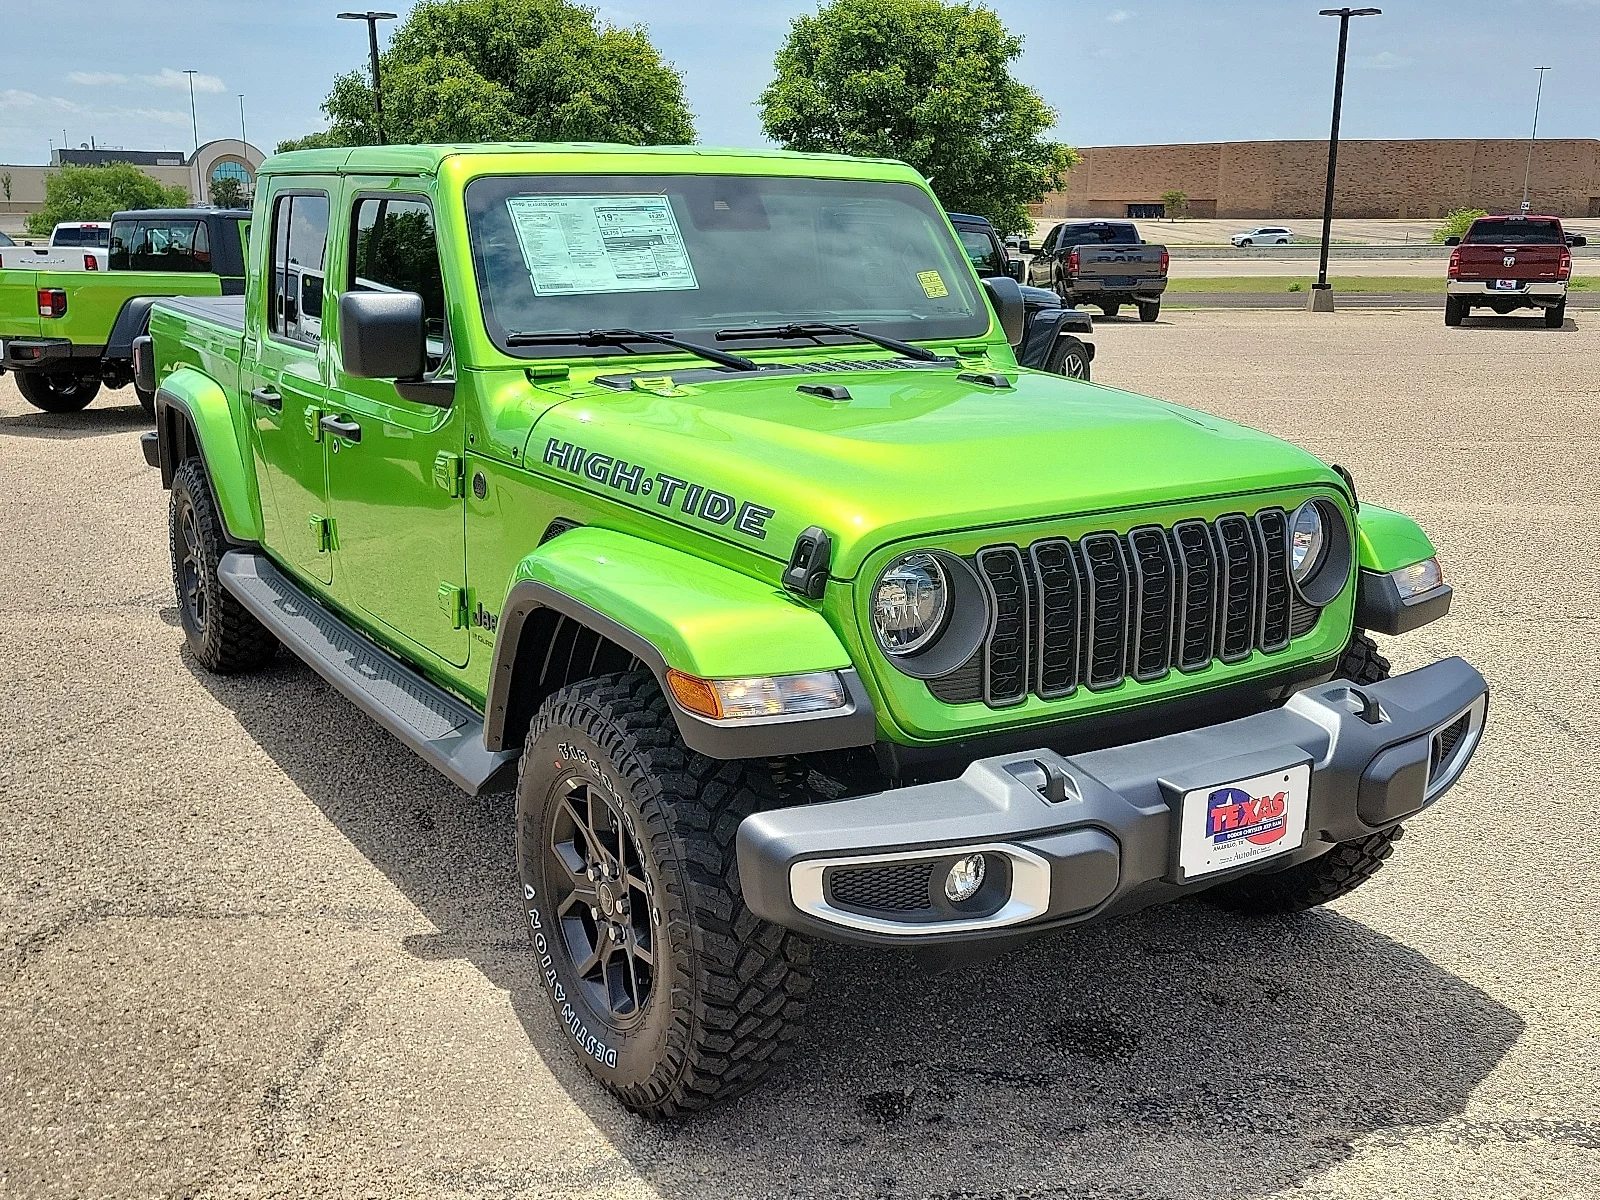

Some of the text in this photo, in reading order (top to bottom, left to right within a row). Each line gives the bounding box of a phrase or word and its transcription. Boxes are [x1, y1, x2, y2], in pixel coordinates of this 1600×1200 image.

[601, 213, 613, 222] 19
[543, 437, 776, 540] HIGH TIDE
[1210, 791, 1286, 832] TEXAS
[527, 908, 618, 1069] DESTINATION
